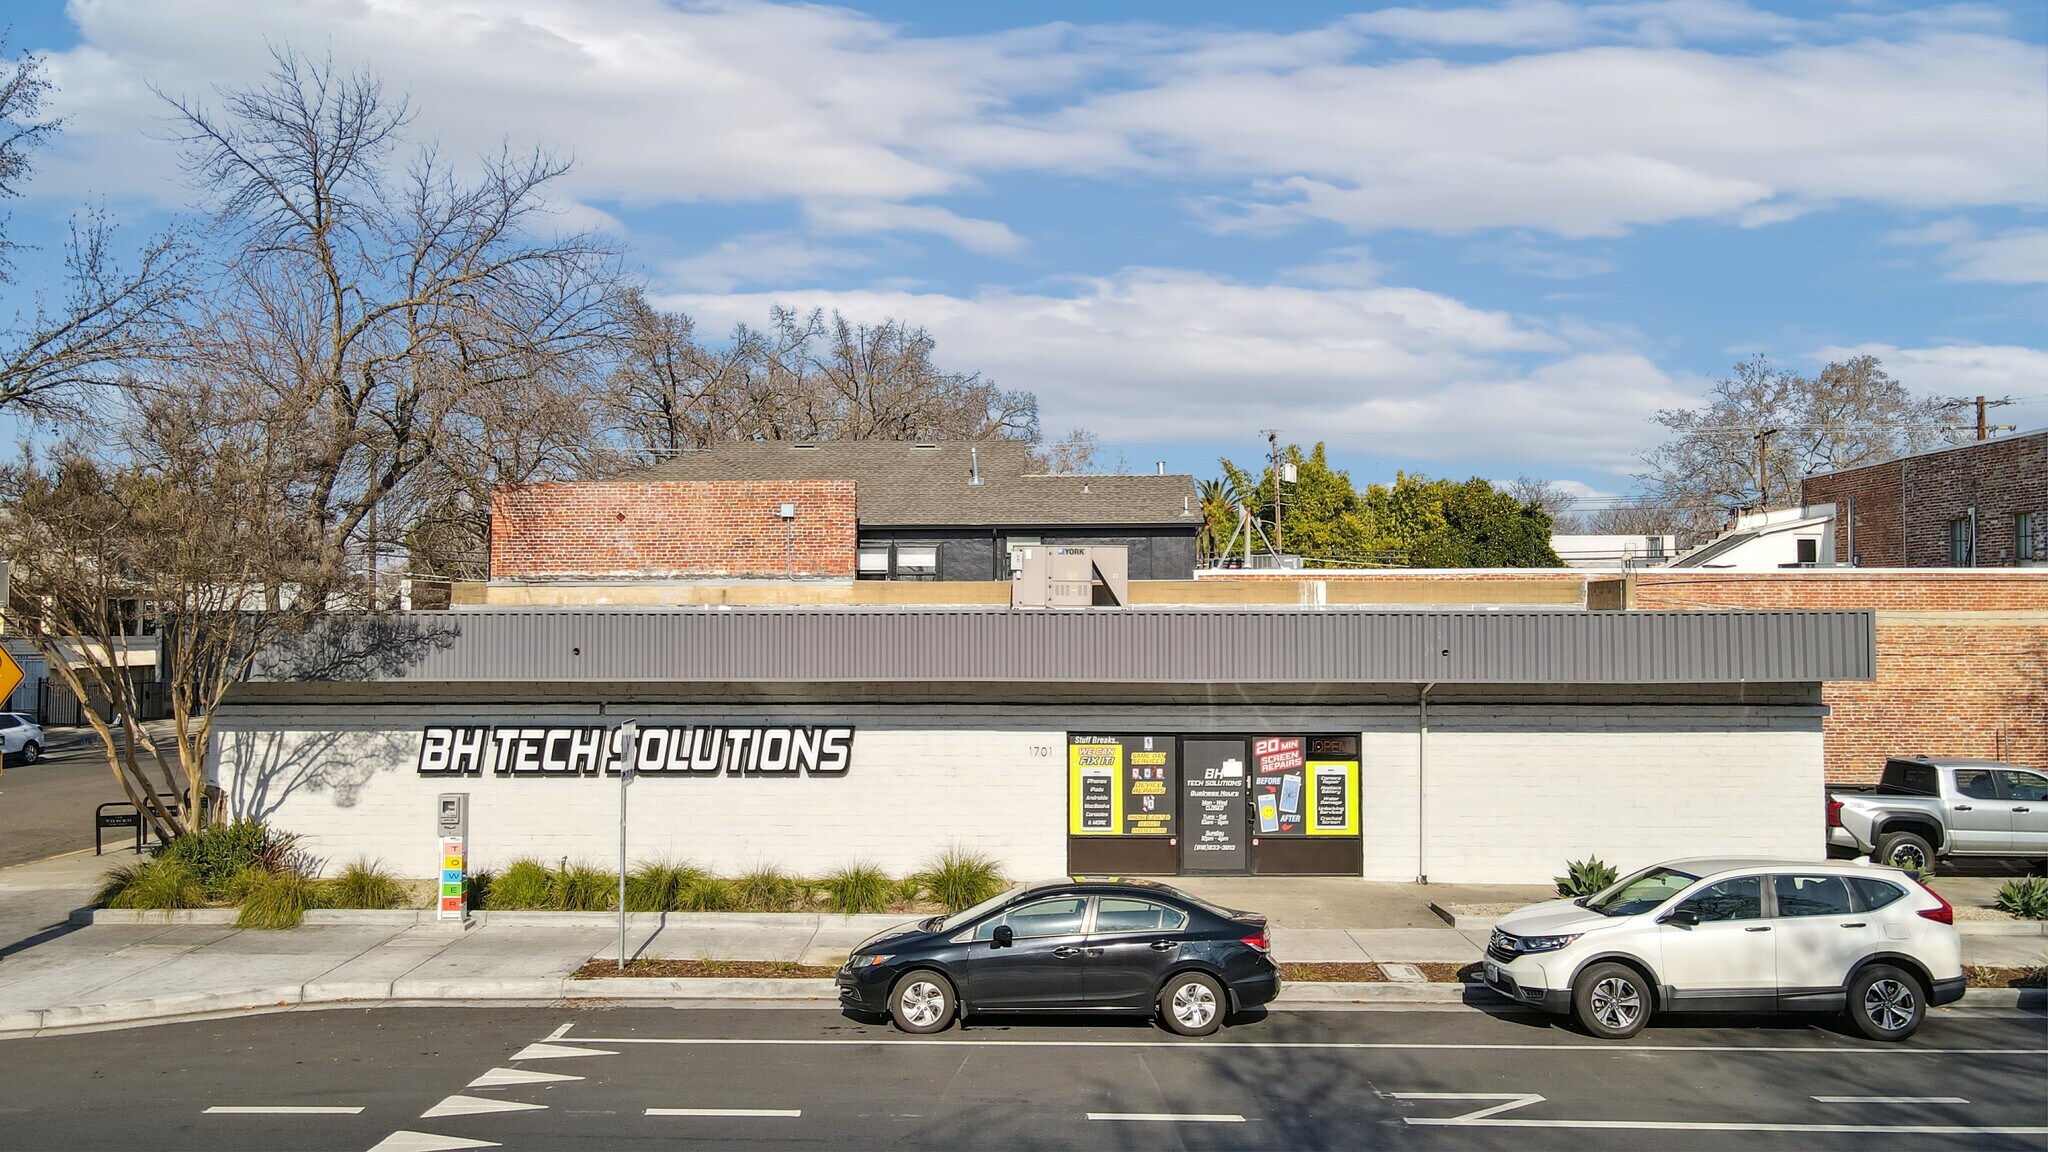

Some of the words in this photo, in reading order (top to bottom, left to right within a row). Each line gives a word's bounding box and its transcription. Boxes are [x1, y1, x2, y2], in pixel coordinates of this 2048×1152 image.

[418, 726, 489, 773] BH
[494, 726, 605, 773] TECH
[606, 726, 855, 774] SOLUTIONS
[1029, 746, 1052, 757] 1701
[1256, 739, 1279, 755] 20
[1281, 741, 1298, 750] MIN
[1315, 741, 1346, 752] OPEN
[1080, 757, 1099, 765] FIX
[1101, 757, 1115, 765] IT!
[1262, 752, 1299, 764] SCREEN
[1262, 759, 1301, 772] REPAIRS
[1205, 768, 1223, 779] BH
[1256, 777, 1281, 785] BEFORE
[448, 845, 460, 907] TOWER
